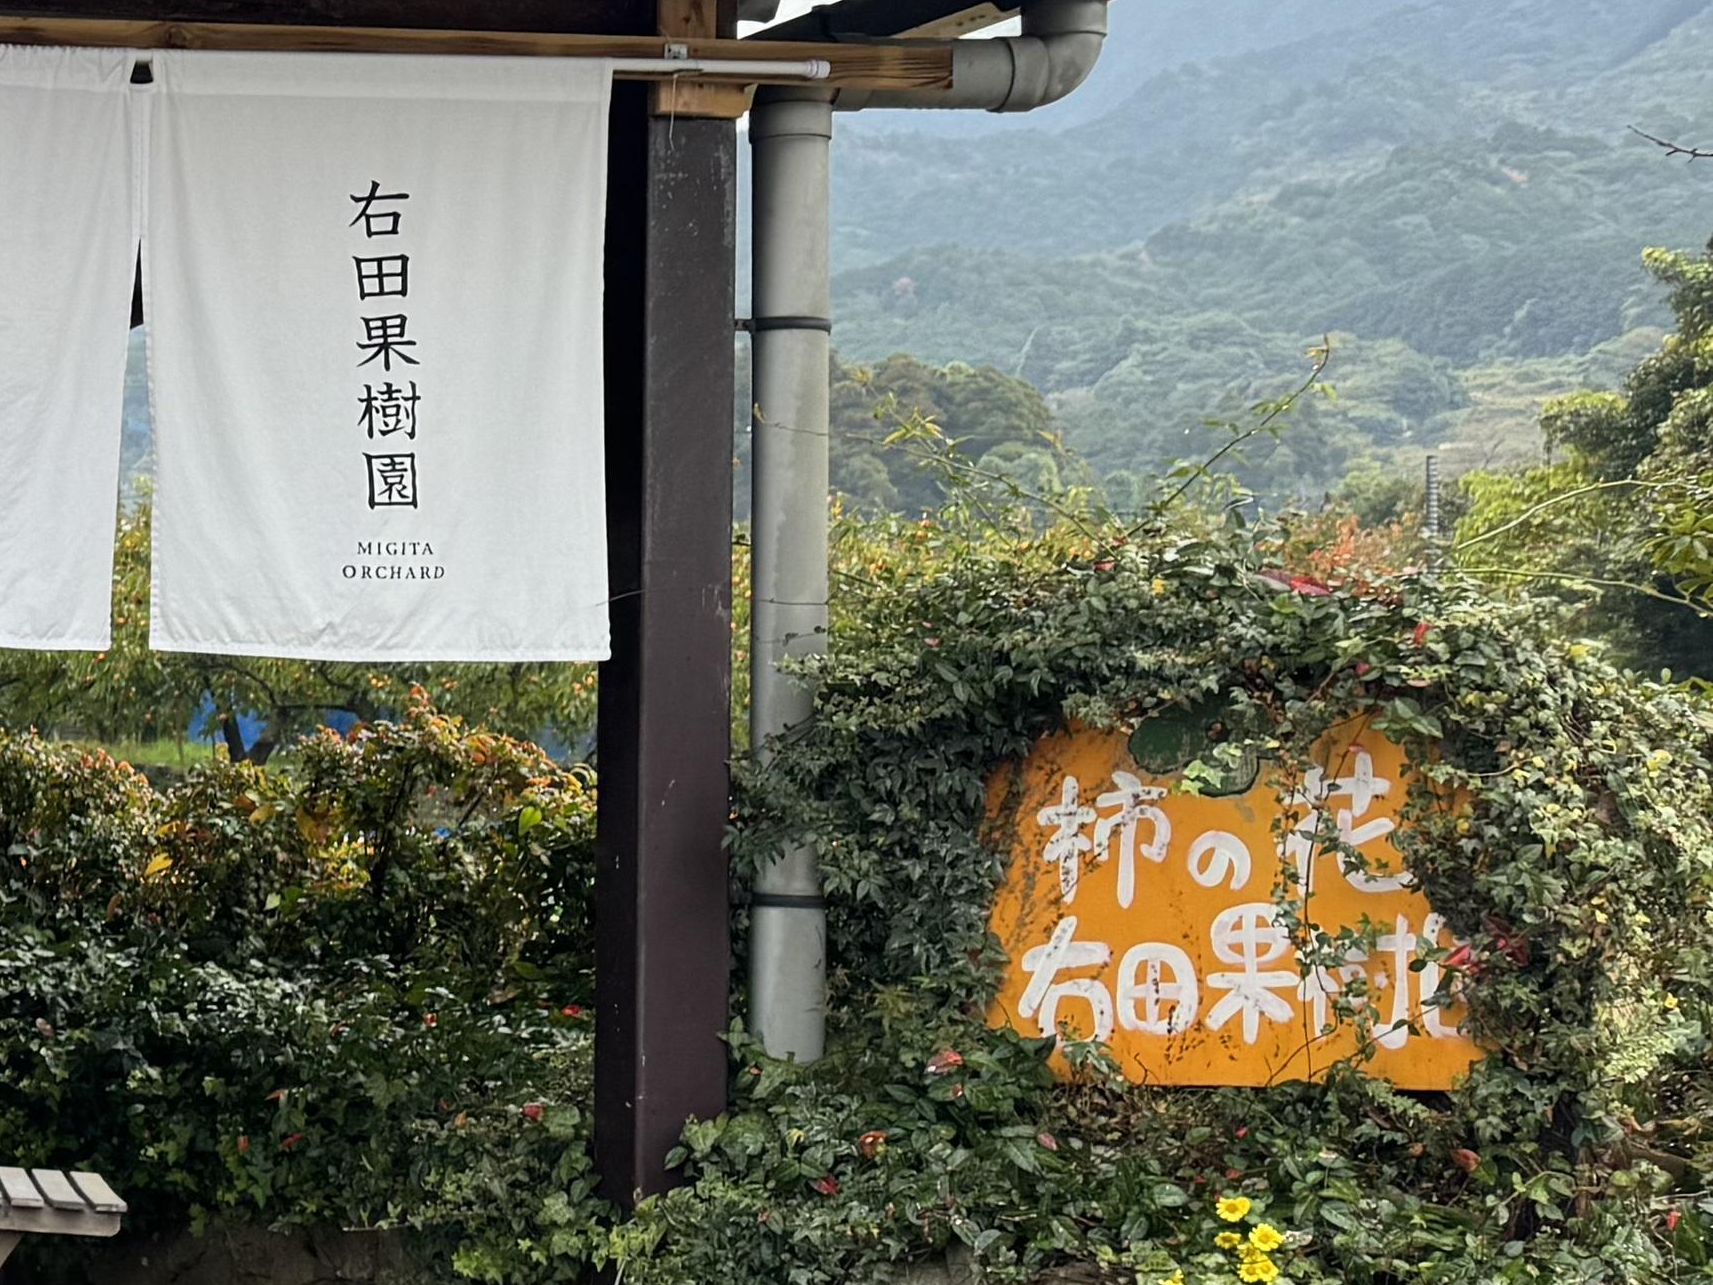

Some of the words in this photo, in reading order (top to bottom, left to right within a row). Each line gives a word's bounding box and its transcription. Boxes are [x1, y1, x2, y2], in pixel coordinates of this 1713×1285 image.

[349, 180, 420, 510] 右田果樹園
[357, 541, 434, 556] MIGITA
[342, 564, 445, 580] ORCHARD
